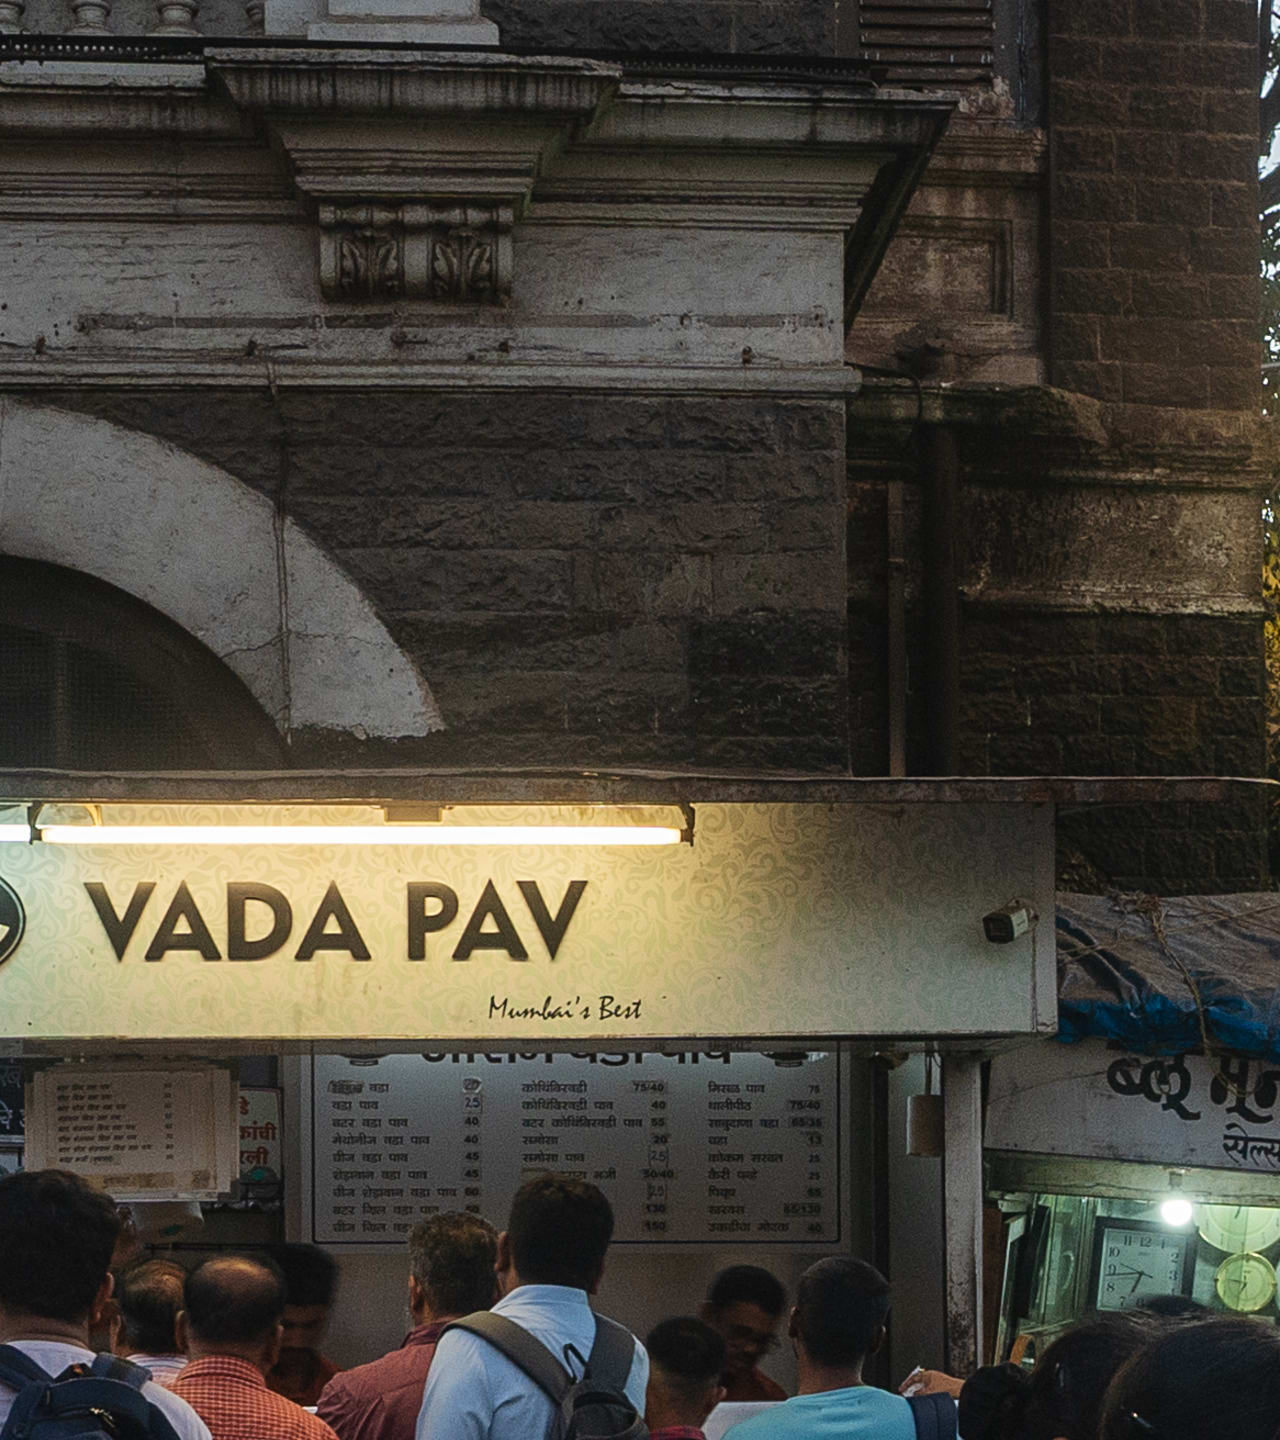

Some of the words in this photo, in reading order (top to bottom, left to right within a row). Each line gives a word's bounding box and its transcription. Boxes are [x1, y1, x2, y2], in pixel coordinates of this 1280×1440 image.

[83, 880, 371, 962] VADA
[407, 878, 588, 961] PAV
[488, 996, 592, 1020] Mumbai's
[600, 996, 641, 1018] Best
[465, 1116, 479, 1126] 40
[464, 1134, 479, 1144] 40
[465, 1151, 480, 1161] 45
